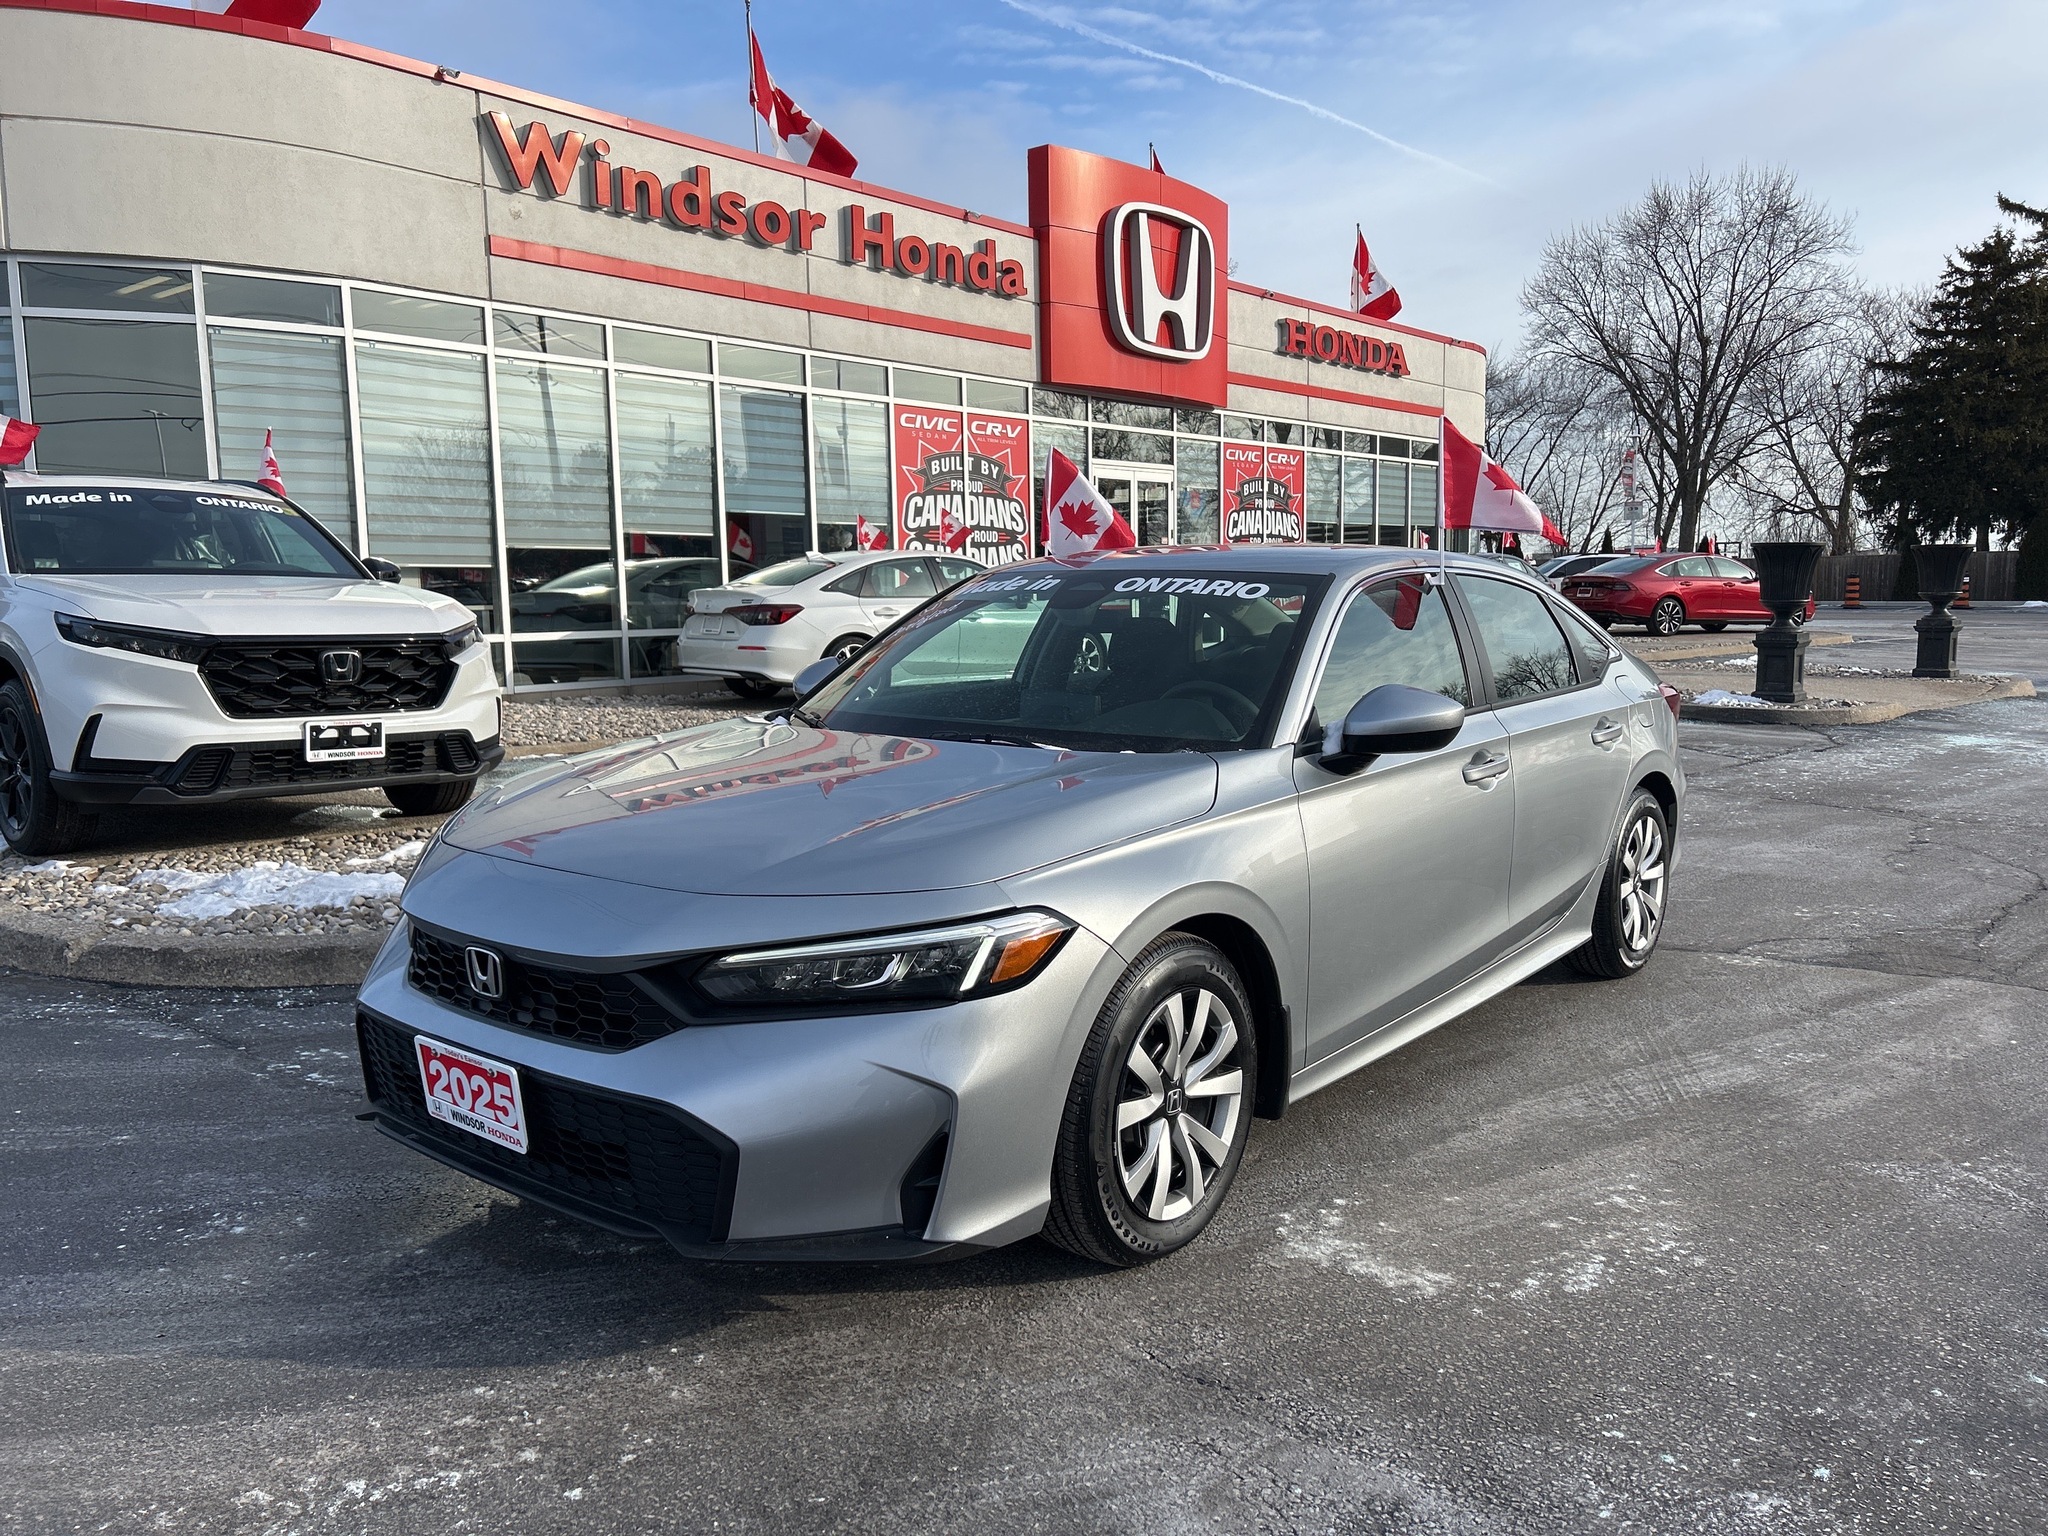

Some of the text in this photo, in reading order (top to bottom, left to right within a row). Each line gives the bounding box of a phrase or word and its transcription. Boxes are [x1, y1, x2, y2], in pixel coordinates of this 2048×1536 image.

[483, 110, 1028, 297] Windsor Honda
[1280, 318, 1411, 376] HONDA
[900, 413, 958, 432] CIVIC
[971, 421, 1022, 438] CR-V
[912, 430, 947, 440] SEDAN
[1226, 449, 1261, 462] CIVIC
[1268, 453, 1300, 465] CR-V
[931, 456, 999, 479] BUILT BY
[1243, 480, 1285, 498] BUILT BY
[26, 492, 132, 506] Made in
[196, 496, 284, 514] ONTARIO
[906, 494, 1025, 533] CANADIANS
[1228, 510, 1300, 540] CANADIANS
[1024, 574, 1061, 590] in
[1113, 577, 1271, 599] ONTARIO
[428, 1060, 518, 1128] 2025
[450, 1108, 487, 1134] WINDSOR
[487, 1126, 524, 1149] HONDA
